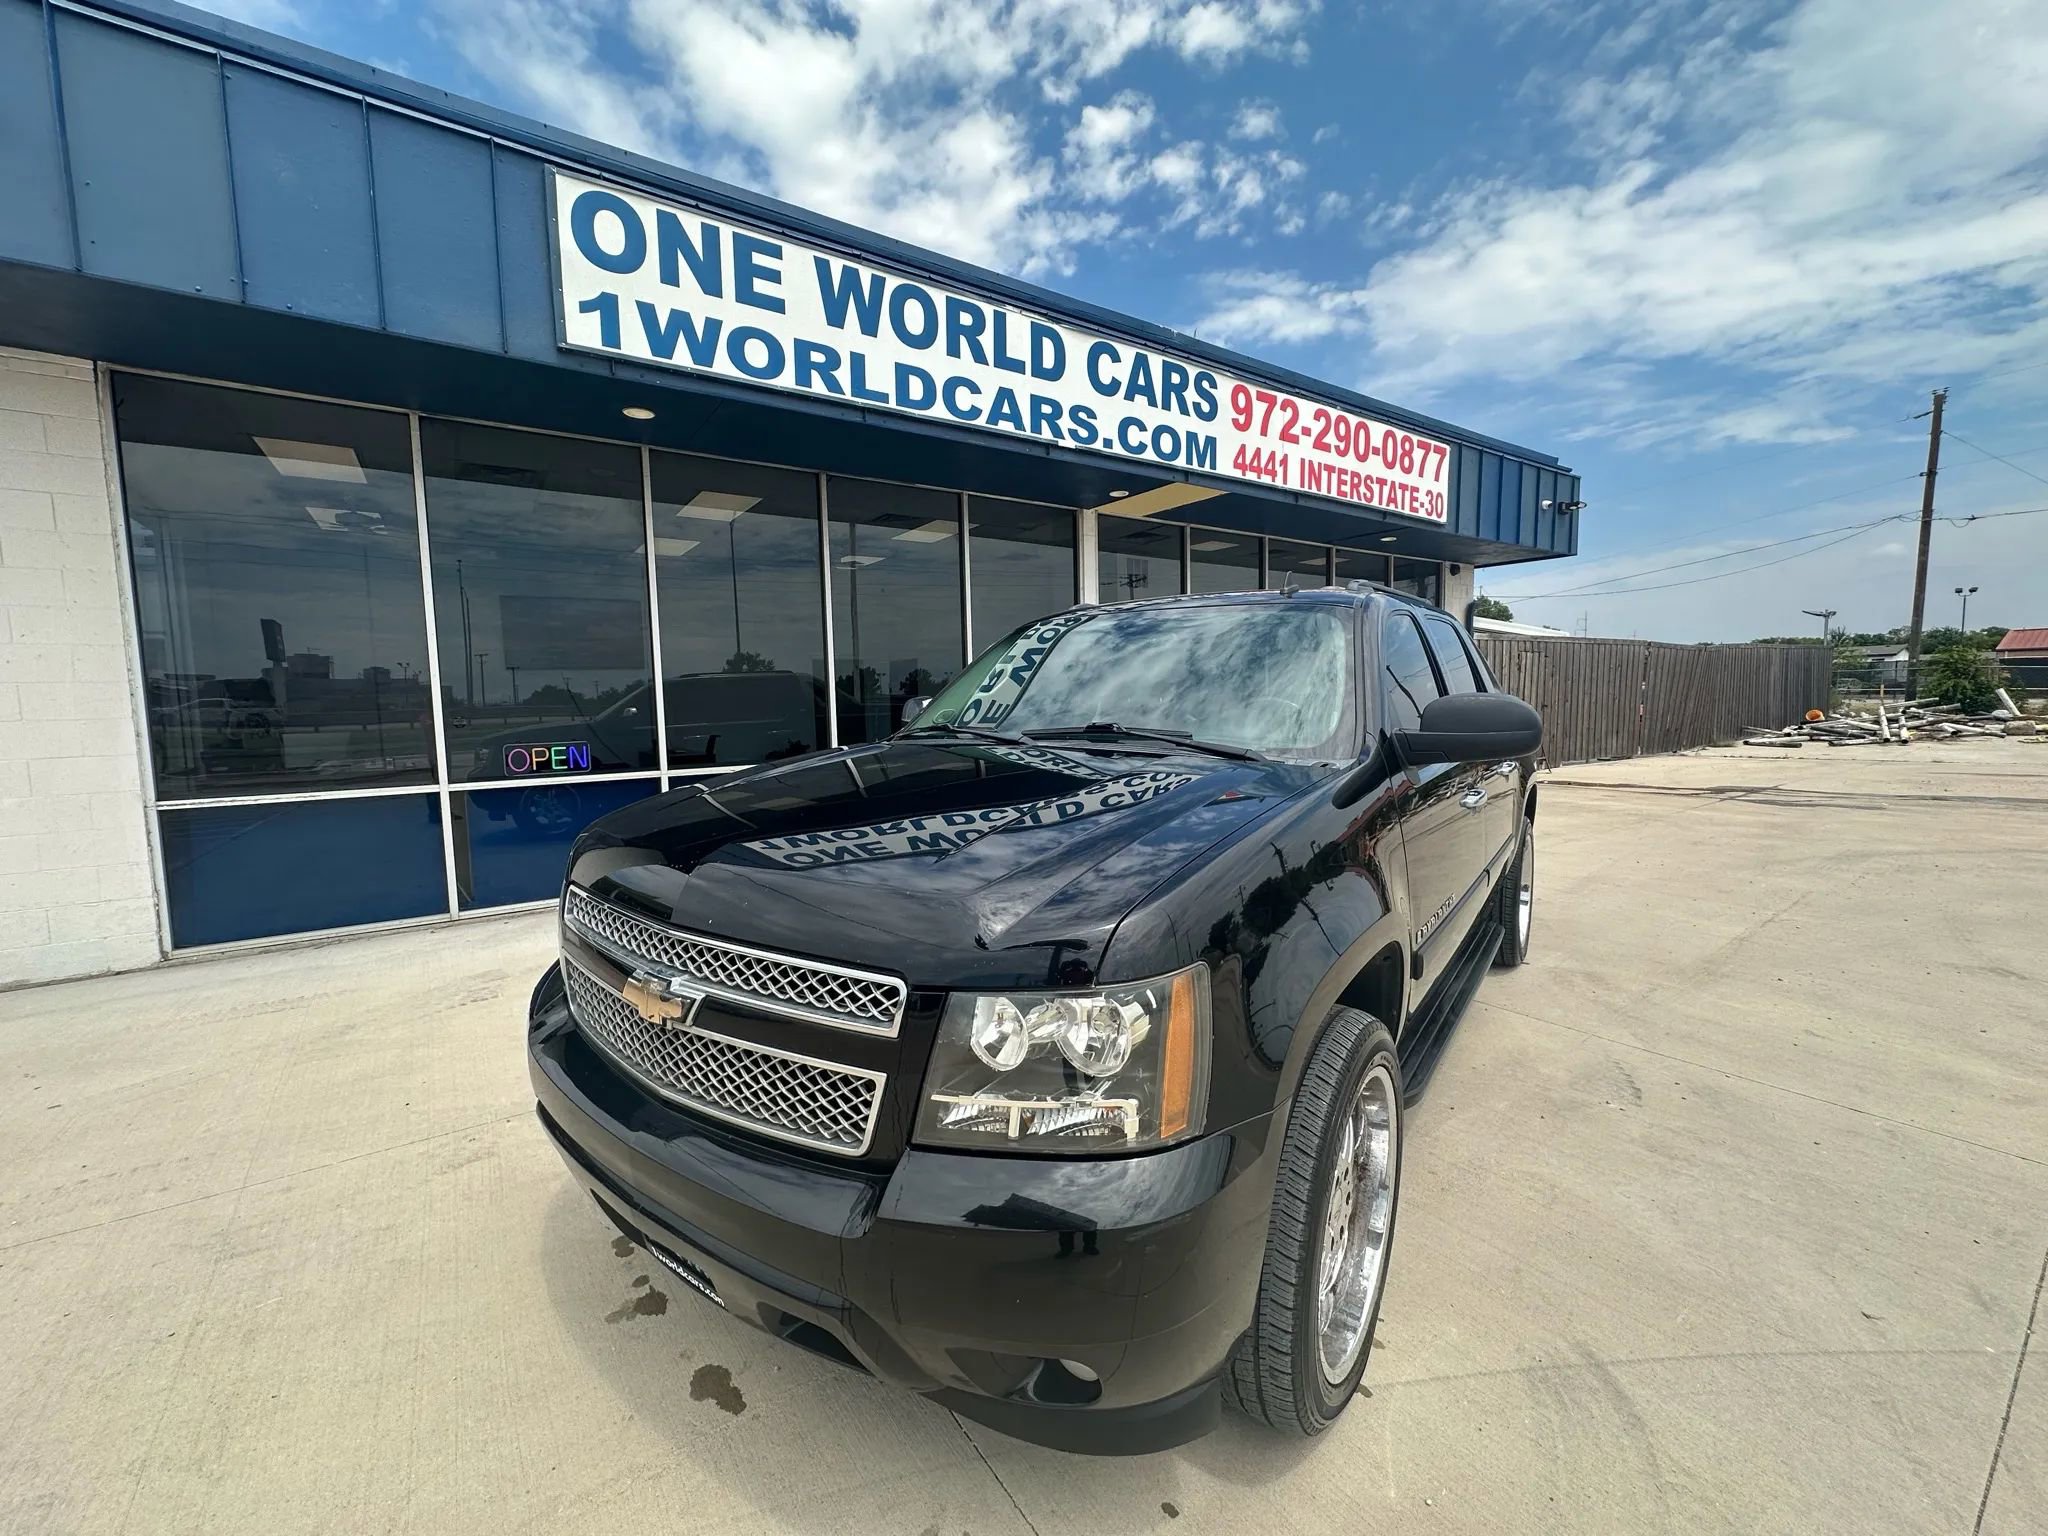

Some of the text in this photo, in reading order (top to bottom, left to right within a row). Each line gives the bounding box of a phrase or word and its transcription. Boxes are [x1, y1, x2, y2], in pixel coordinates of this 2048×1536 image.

[570, 190, 1219, 422] ONE WORLD CARS
[578, 291, 1217, 471] 1WORLDCARS.COM
[1231, 384, 1448, 482] 972-290-0877
[1233, 443, 1444, 519] 4441 INTERSTATE-30
[508, 745, 588, 772] OPEN
